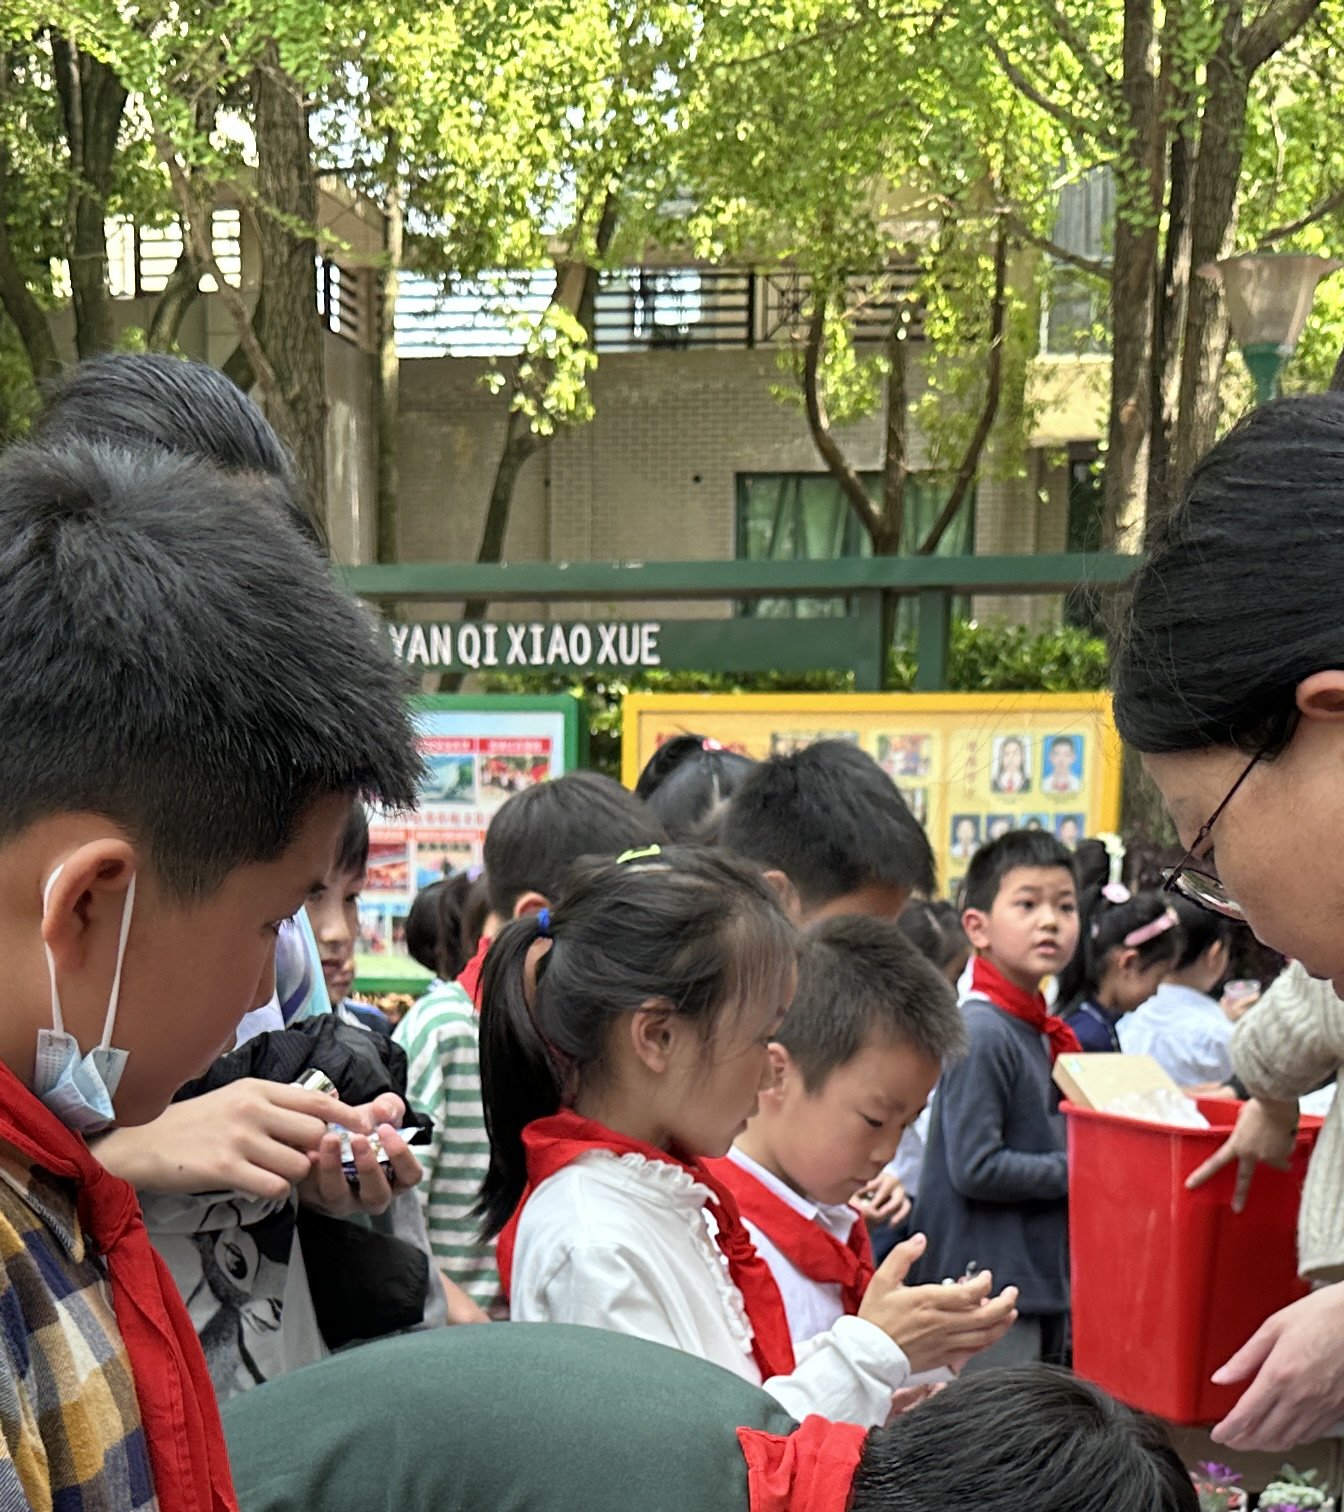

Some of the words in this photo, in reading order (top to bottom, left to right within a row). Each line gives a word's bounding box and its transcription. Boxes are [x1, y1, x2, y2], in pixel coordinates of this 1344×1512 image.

[458, 623, 499, 668] QI
[506, 623, 593, 666] XIAO
[597, 623, 661, 666] XUE
